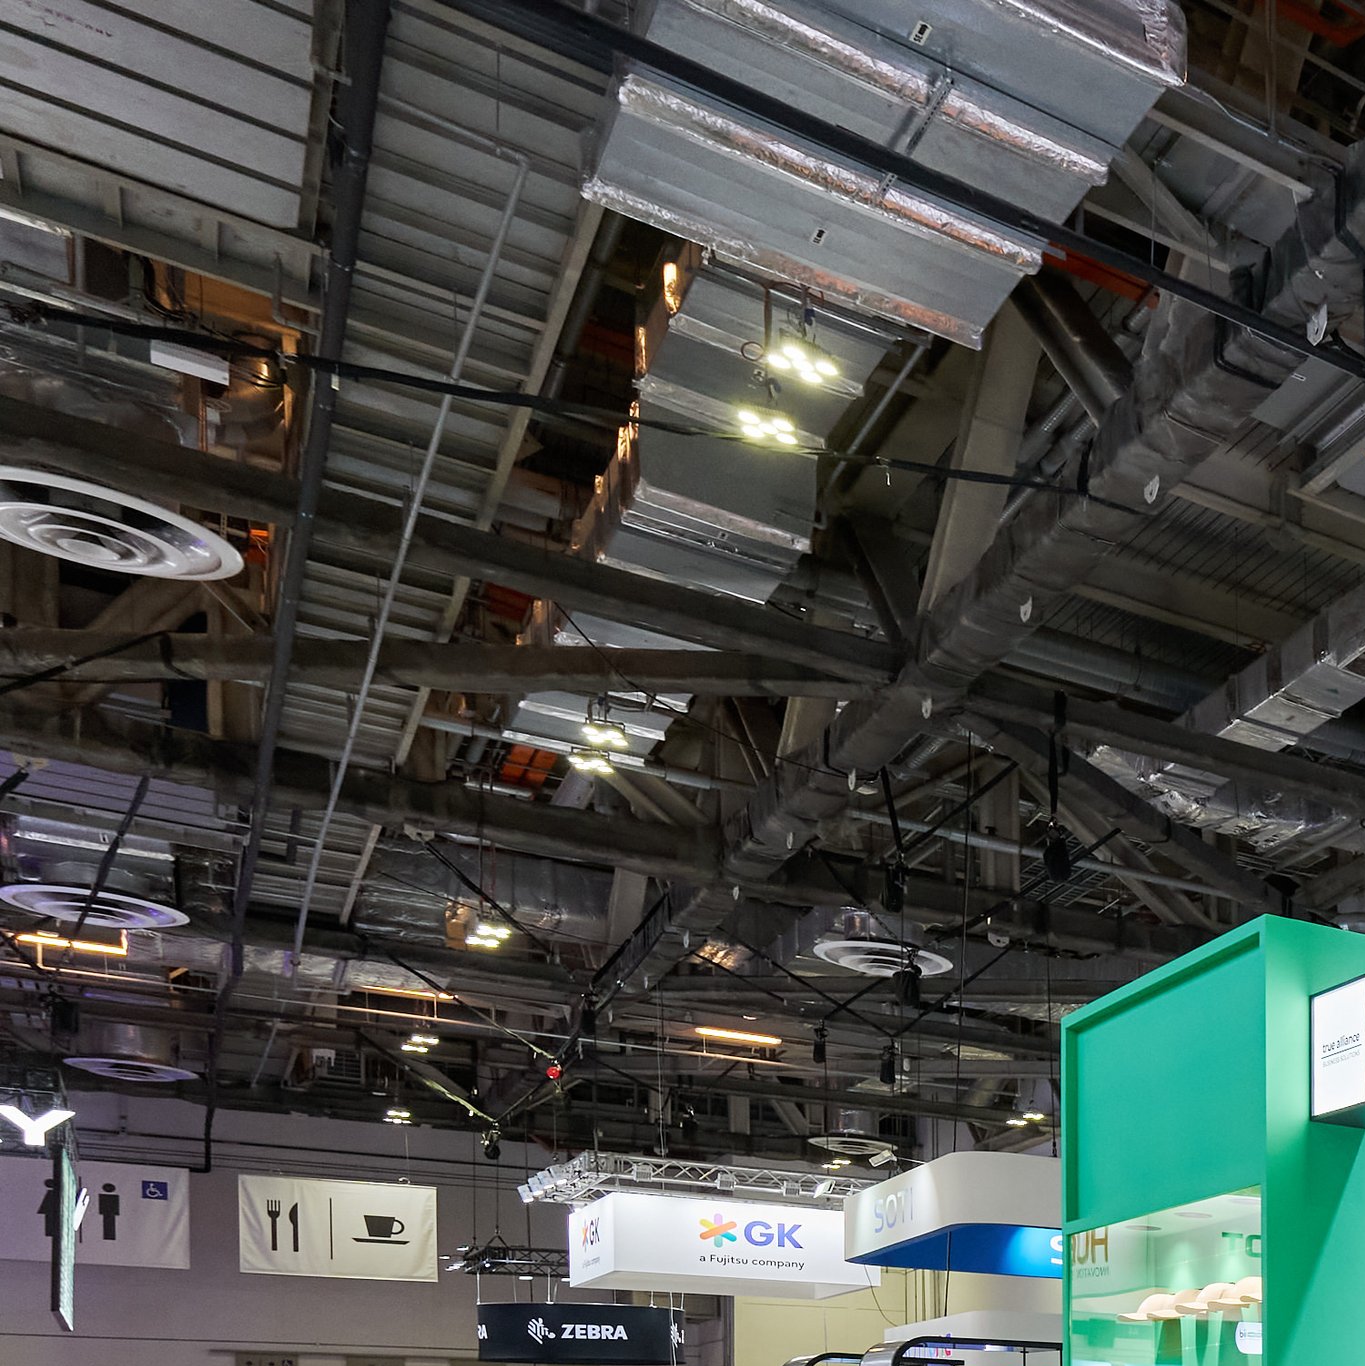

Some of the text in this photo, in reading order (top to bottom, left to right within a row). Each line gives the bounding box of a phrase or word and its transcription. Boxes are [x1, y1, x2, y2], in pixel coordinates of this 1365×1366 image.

[875, 1187, 913, 1233] SOTI
[590, 1217, 599, 1245] GK
[744, 1221, 803, 1249] GK
[710, 1254, 748, 1266] Fujitsu
[752, 1259, 805, 1270] company
[561, 1324, 628, 1341] ZEBRA
